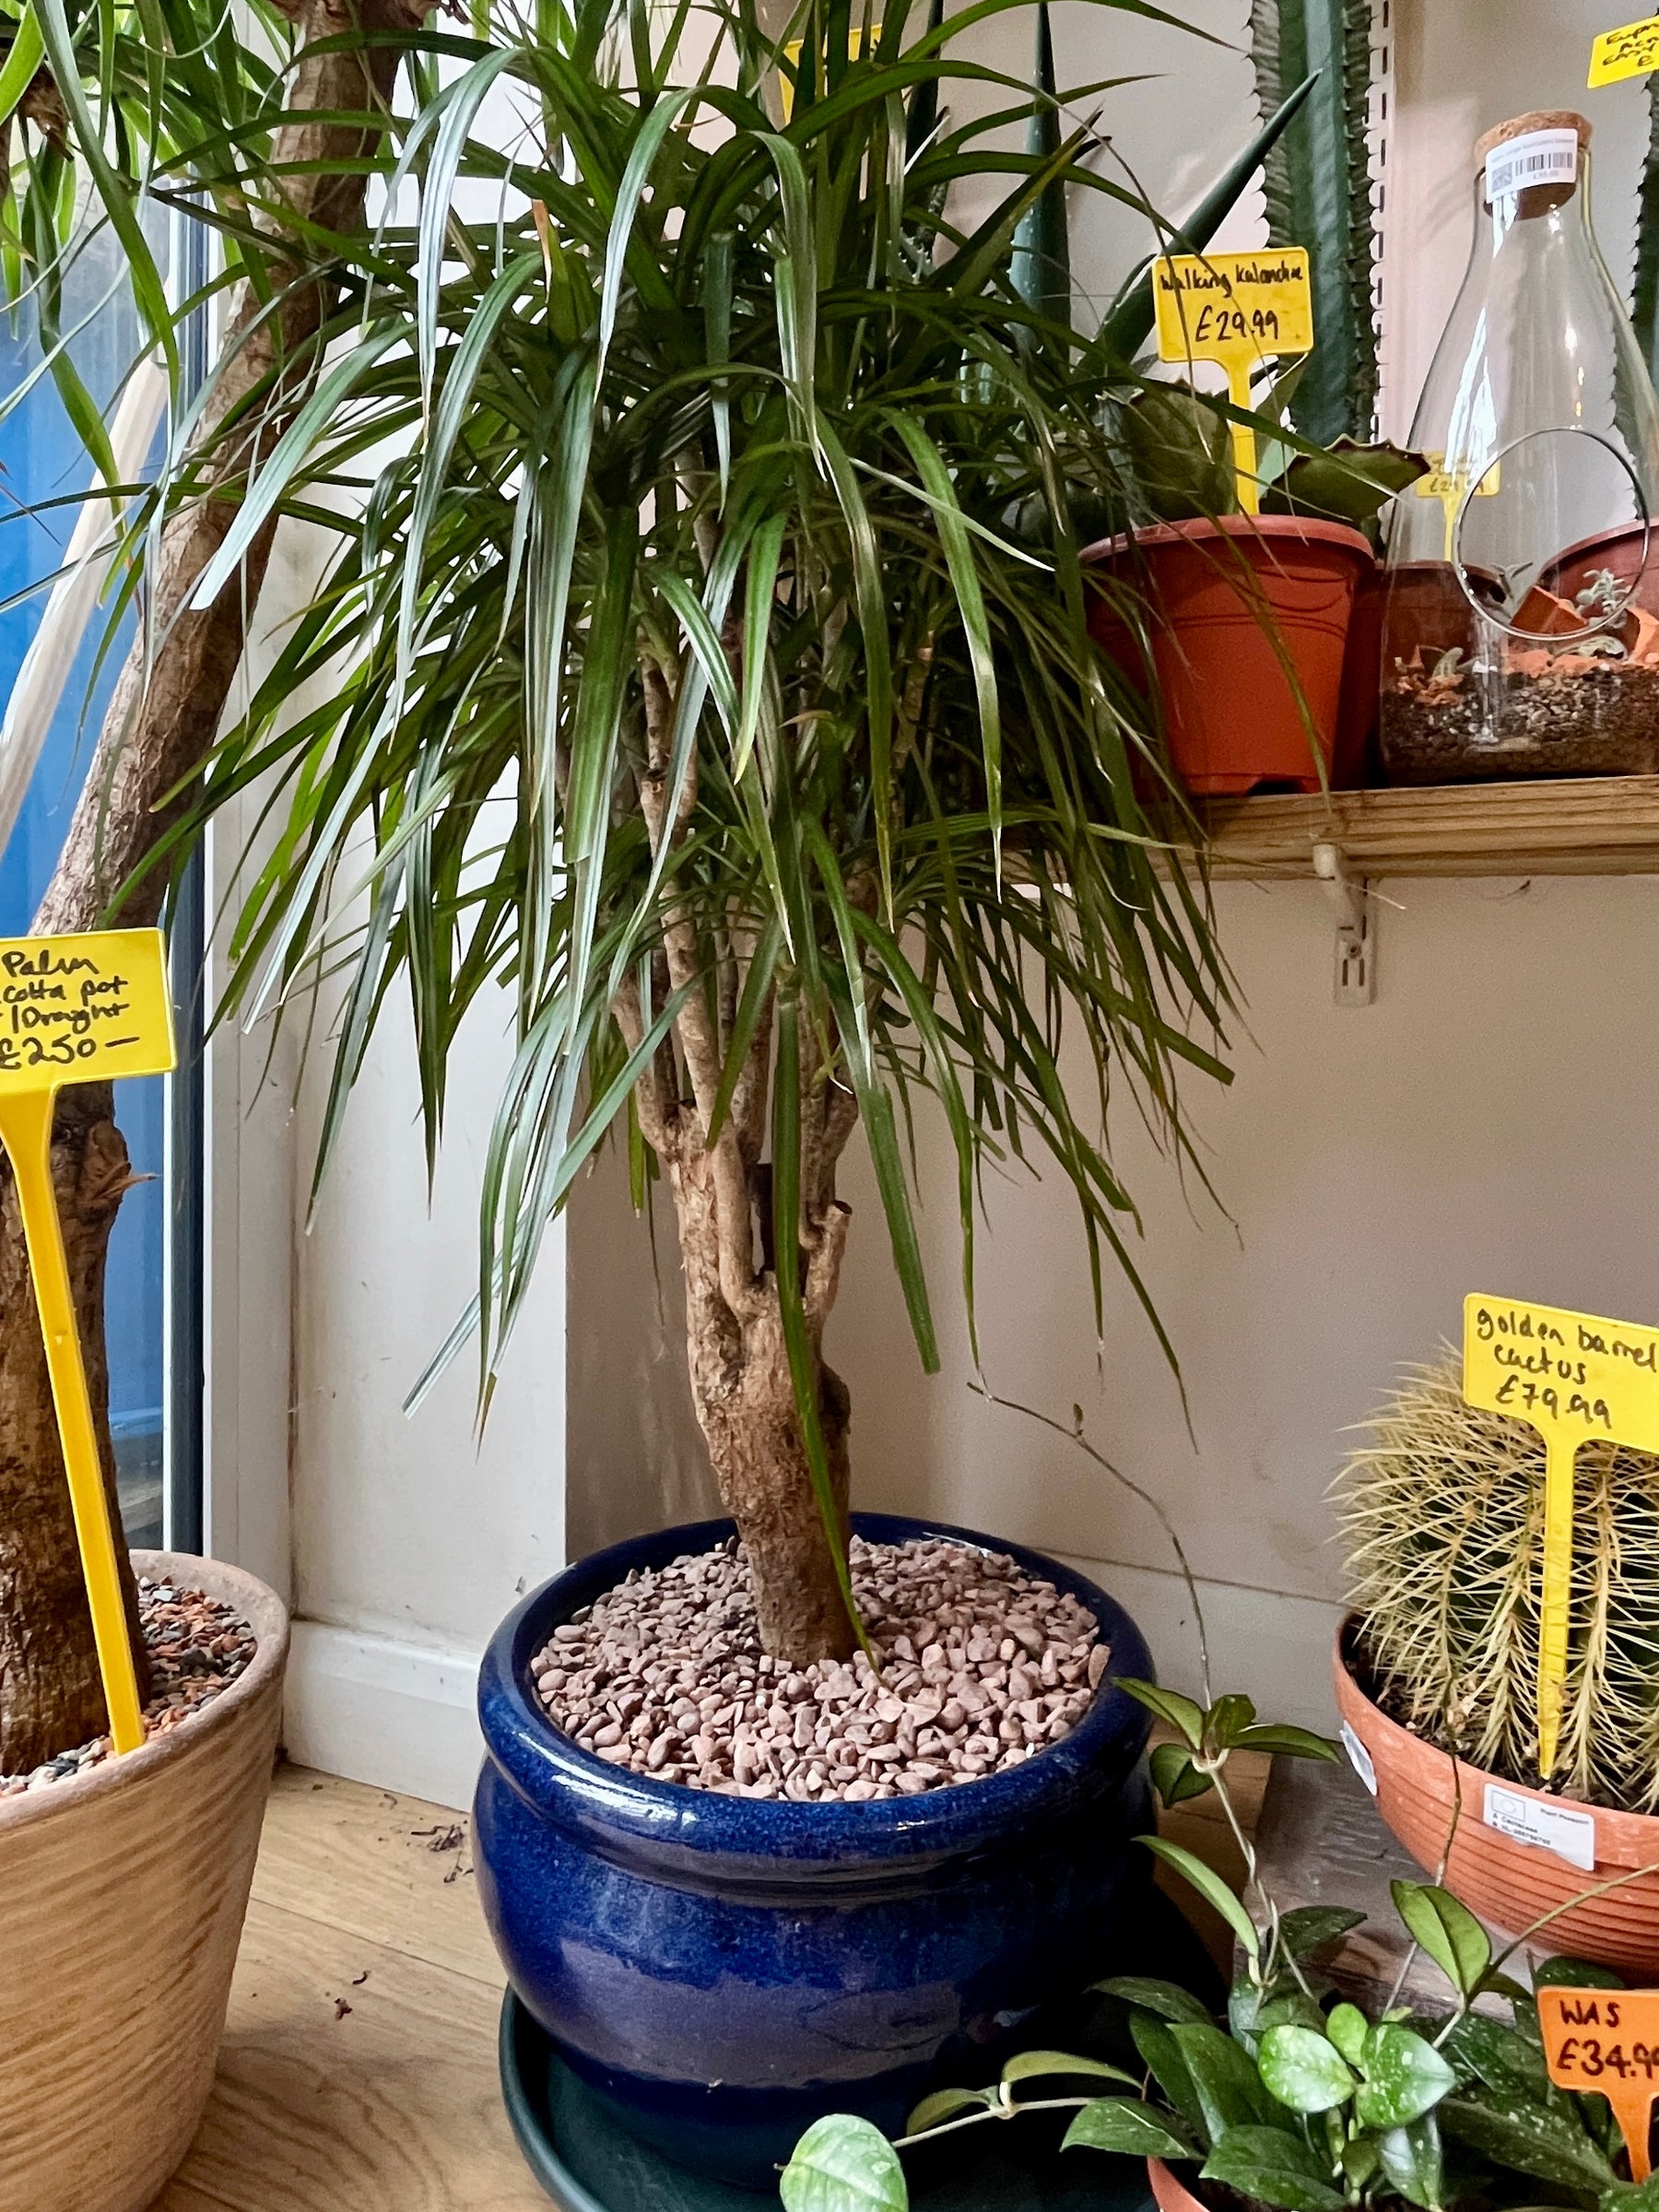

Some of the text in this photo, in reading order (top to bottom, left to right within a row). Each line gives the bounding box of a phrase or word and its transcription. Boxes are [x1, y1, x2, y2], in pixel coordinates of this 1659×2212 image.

[1195, 305, 1278, 342] £29.99
[2, 949, 100, 977] Palm
[81, 976, 128, 1006] pot
[1477, 1309, 1657, 1372] golden barrel
[1494, 1343, 1586, 1384] cactus
[1495, 1374, 1612, 1430] £79.99
[1559, 2000, 1620, 2028] WAS
